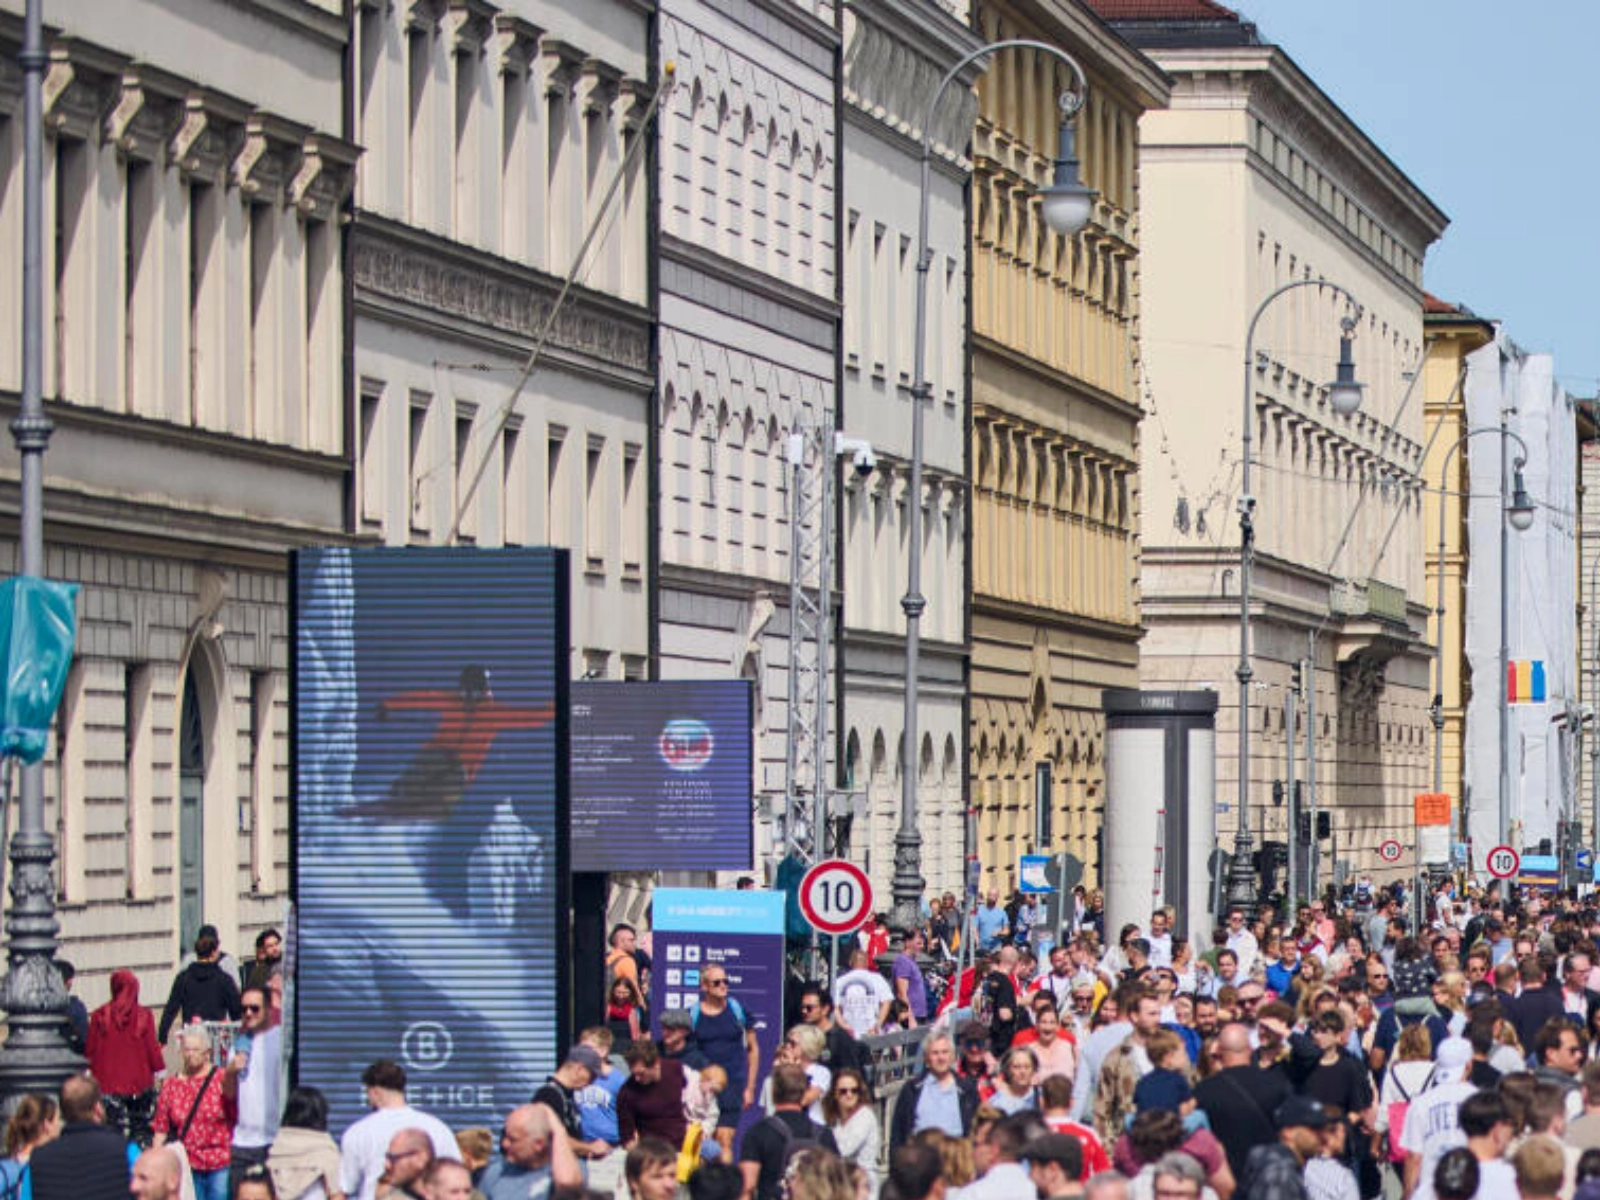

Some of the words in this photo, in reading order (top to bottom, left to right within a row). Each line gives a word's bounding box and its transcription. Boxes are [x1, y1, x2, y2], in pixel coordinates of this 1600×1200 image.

[1495, 855, 1511, 870] 10
[819, 881, 853, 912] 10
[418, 1032, 438, 1060] B
